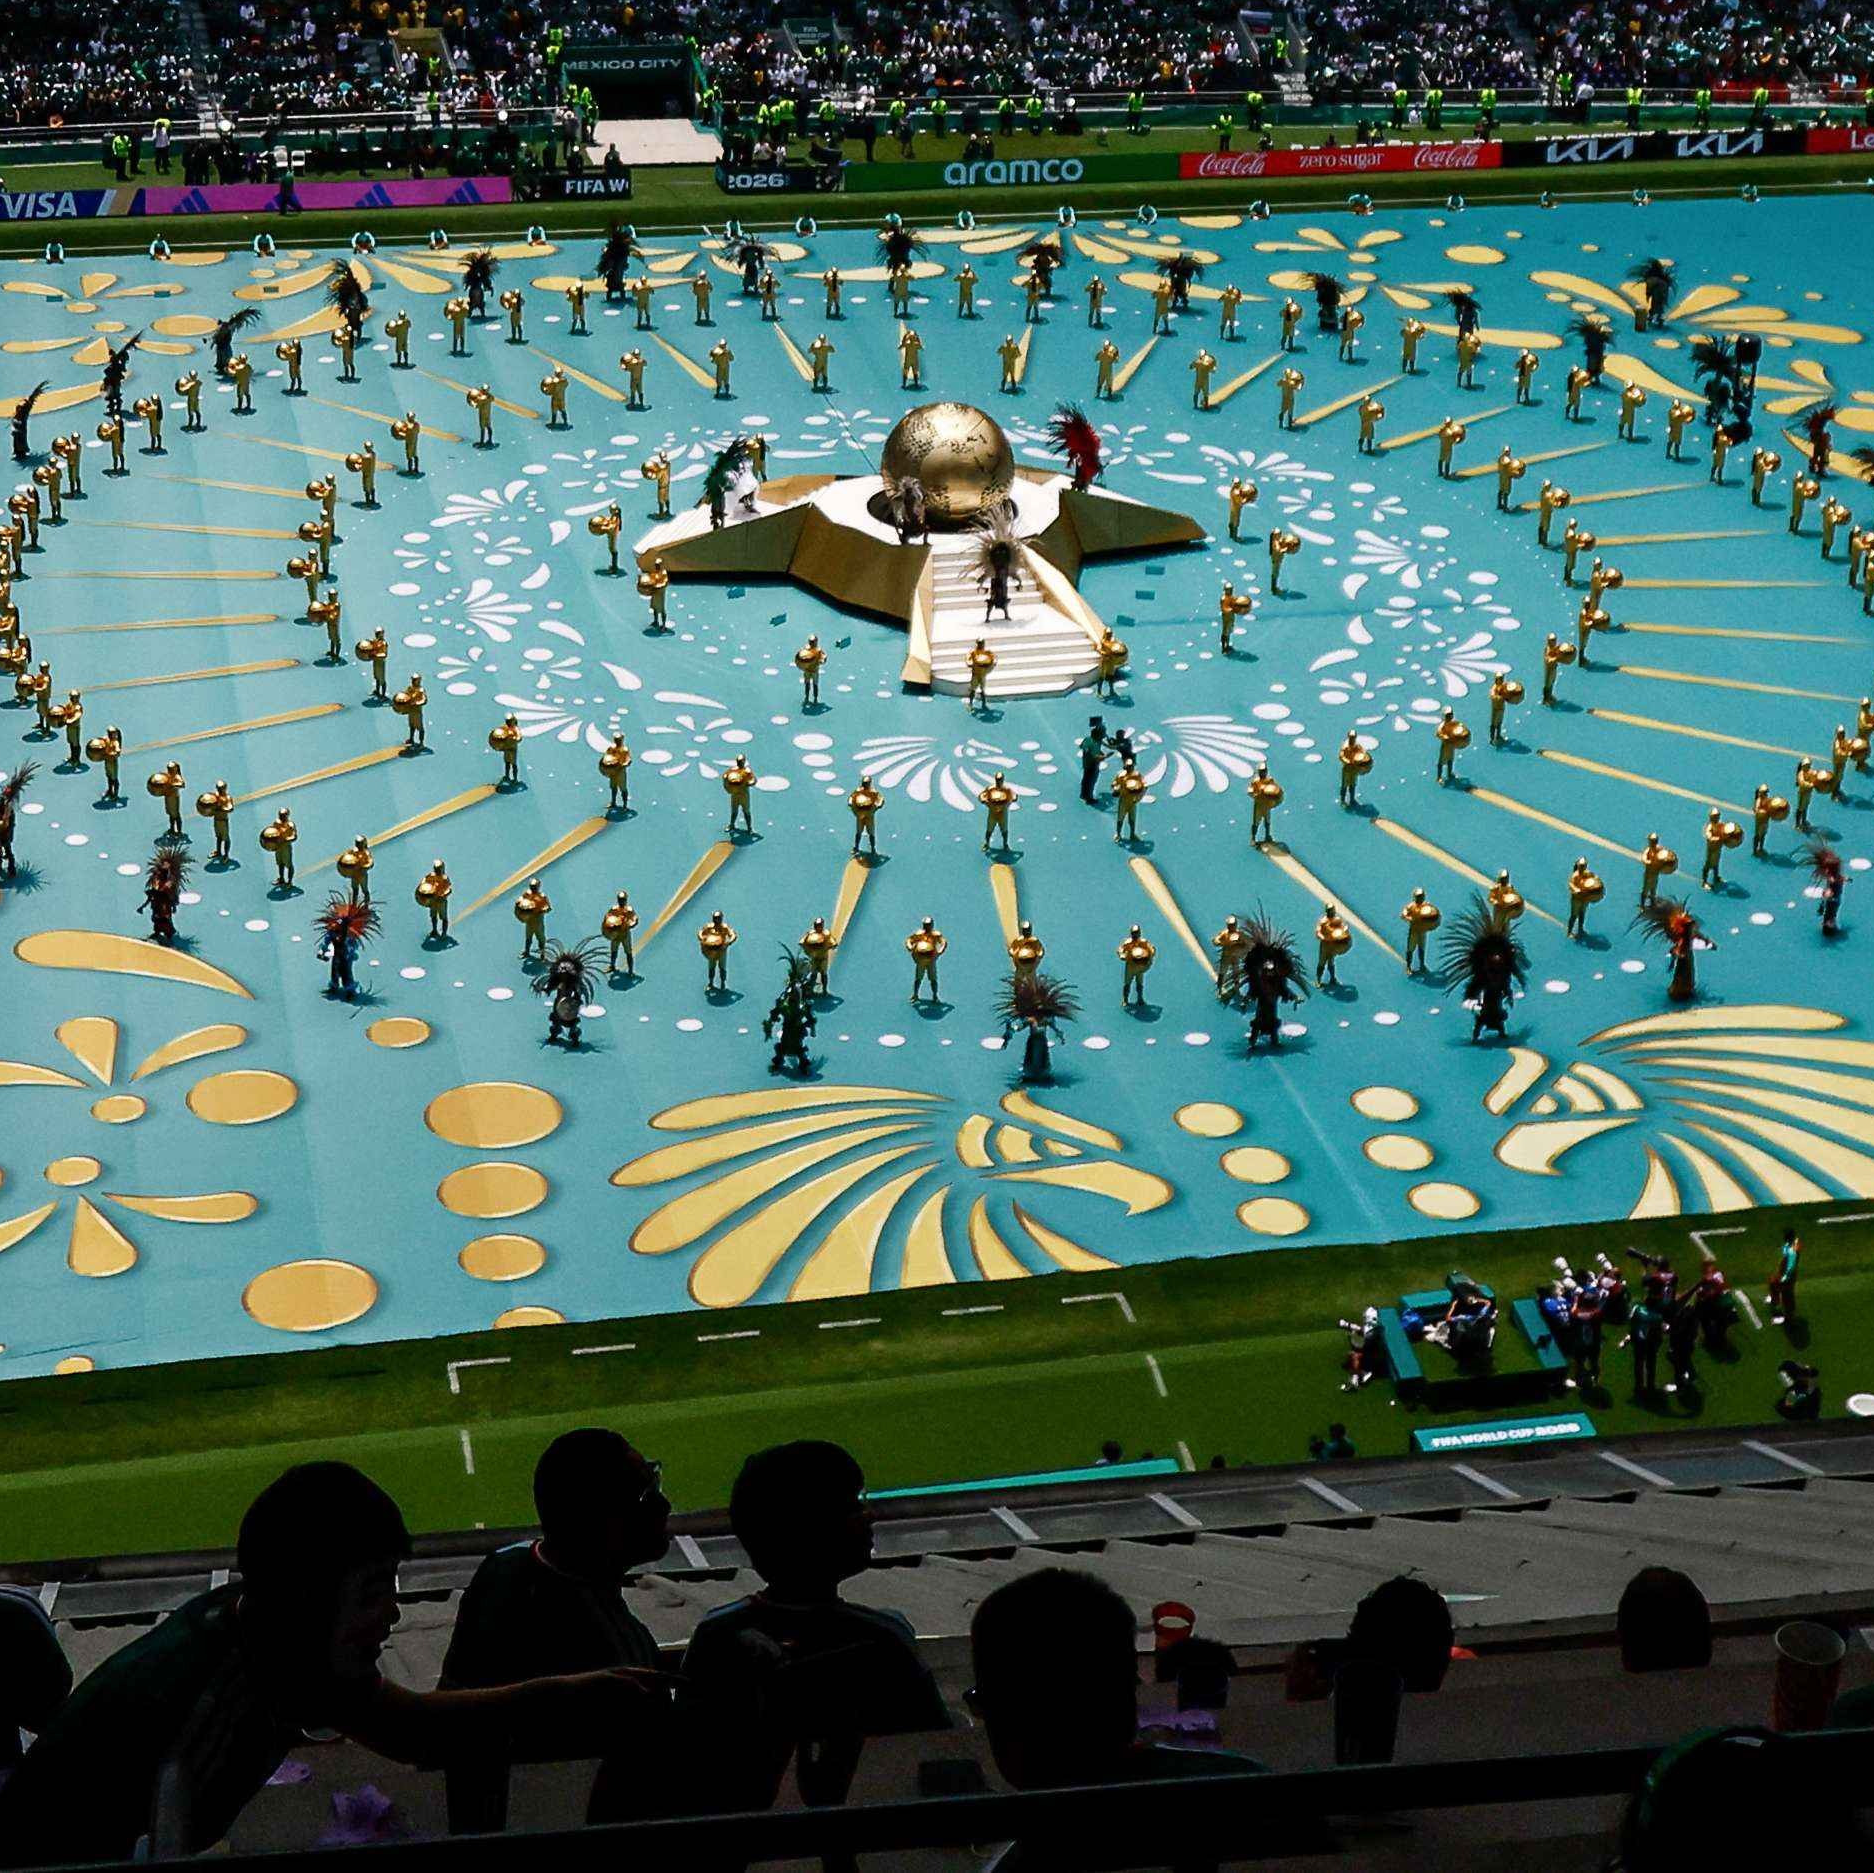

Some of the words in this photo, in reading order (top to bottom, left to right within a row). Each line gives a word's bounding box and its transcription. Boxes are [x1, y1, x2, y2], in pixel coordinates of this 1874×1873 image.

[561, 60, 634, 71] MEXICO
[638, 58, 682, 70] CITY
[944, 158, 1084, 186] aramco
[1299, 154, 1336, 169] zero
[1339, 152, 1385, 172] sugar
[565, 178, 605, 194] FIFA
[608, 178, 629, 193] W
[1431, 1435, 1461, 1448] FIFA
[1462, 1429, 1508, 1445] WORLD
[1509, 1428, 1534, 1439] CUP
